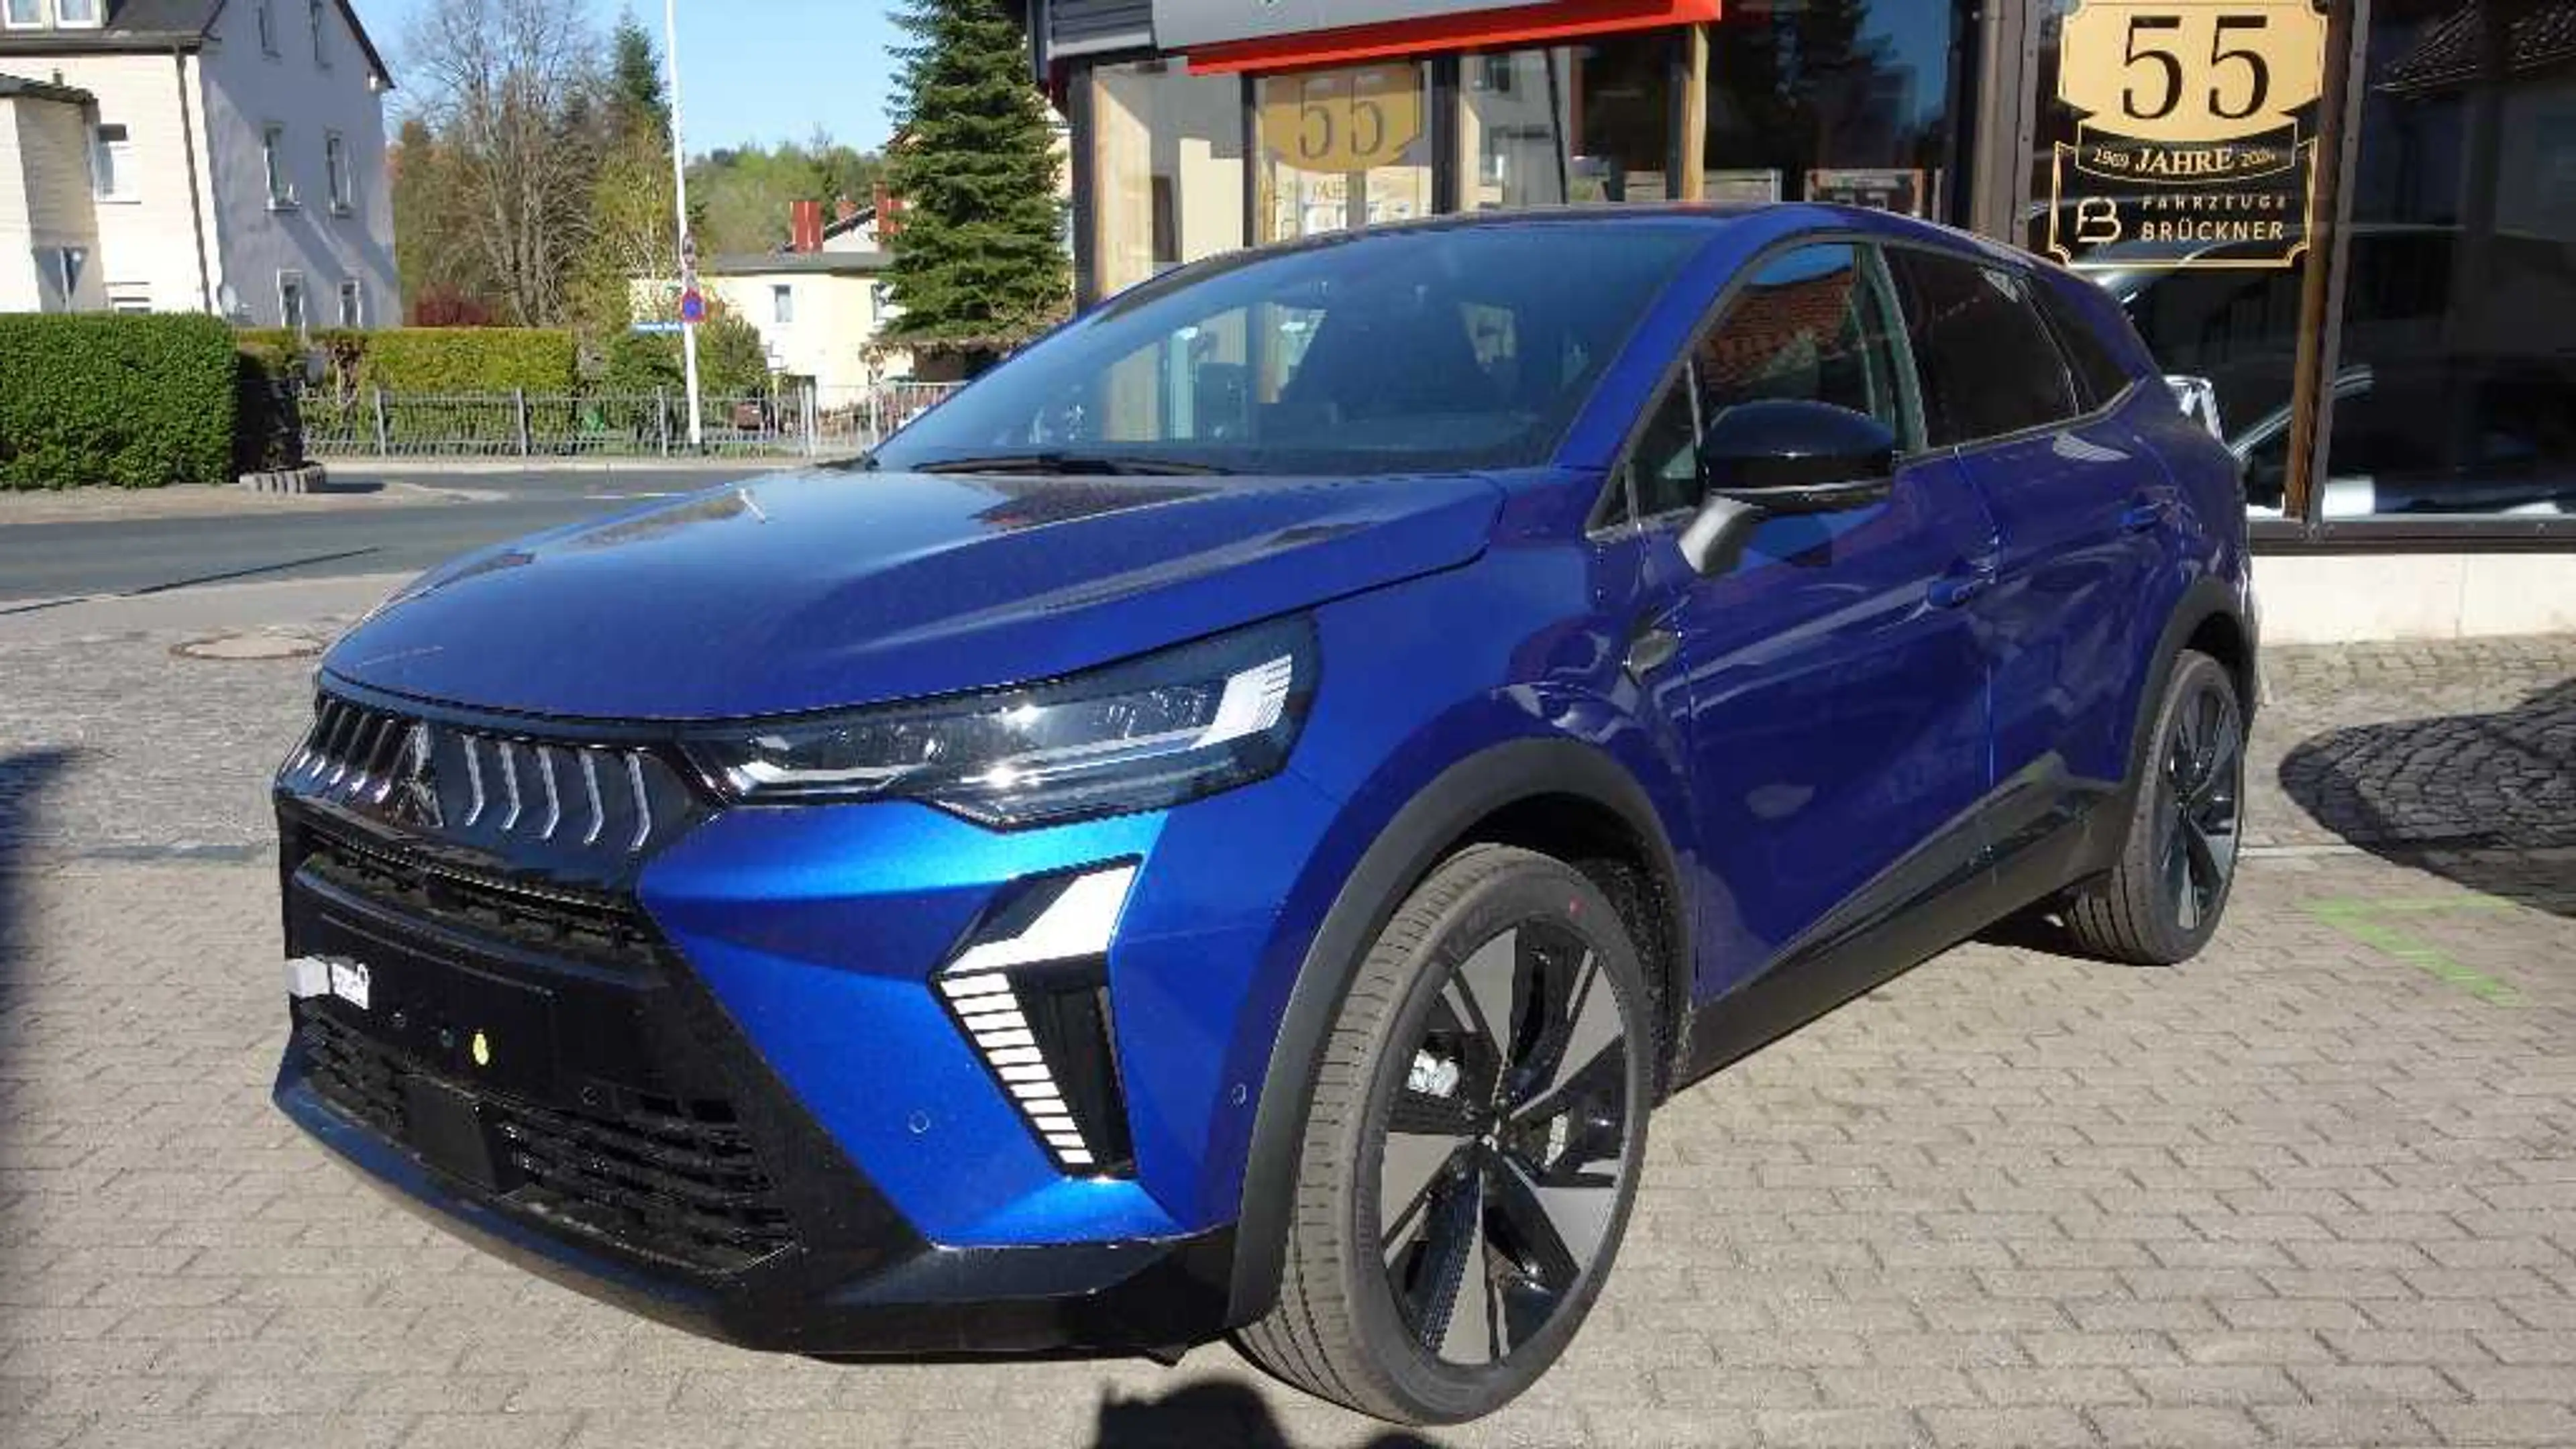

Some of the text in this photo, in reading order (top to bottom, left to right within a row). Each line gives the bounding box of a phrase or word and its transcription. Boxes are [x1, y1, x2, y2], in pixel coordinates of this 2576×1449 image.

[2123, 15, 2269, 119] 55
[1299, 75, 1384, 160] 55
[2135, 148, 2236, 175] JAHRE
[2141, 217, 2284, 242] BRÜCKNER
